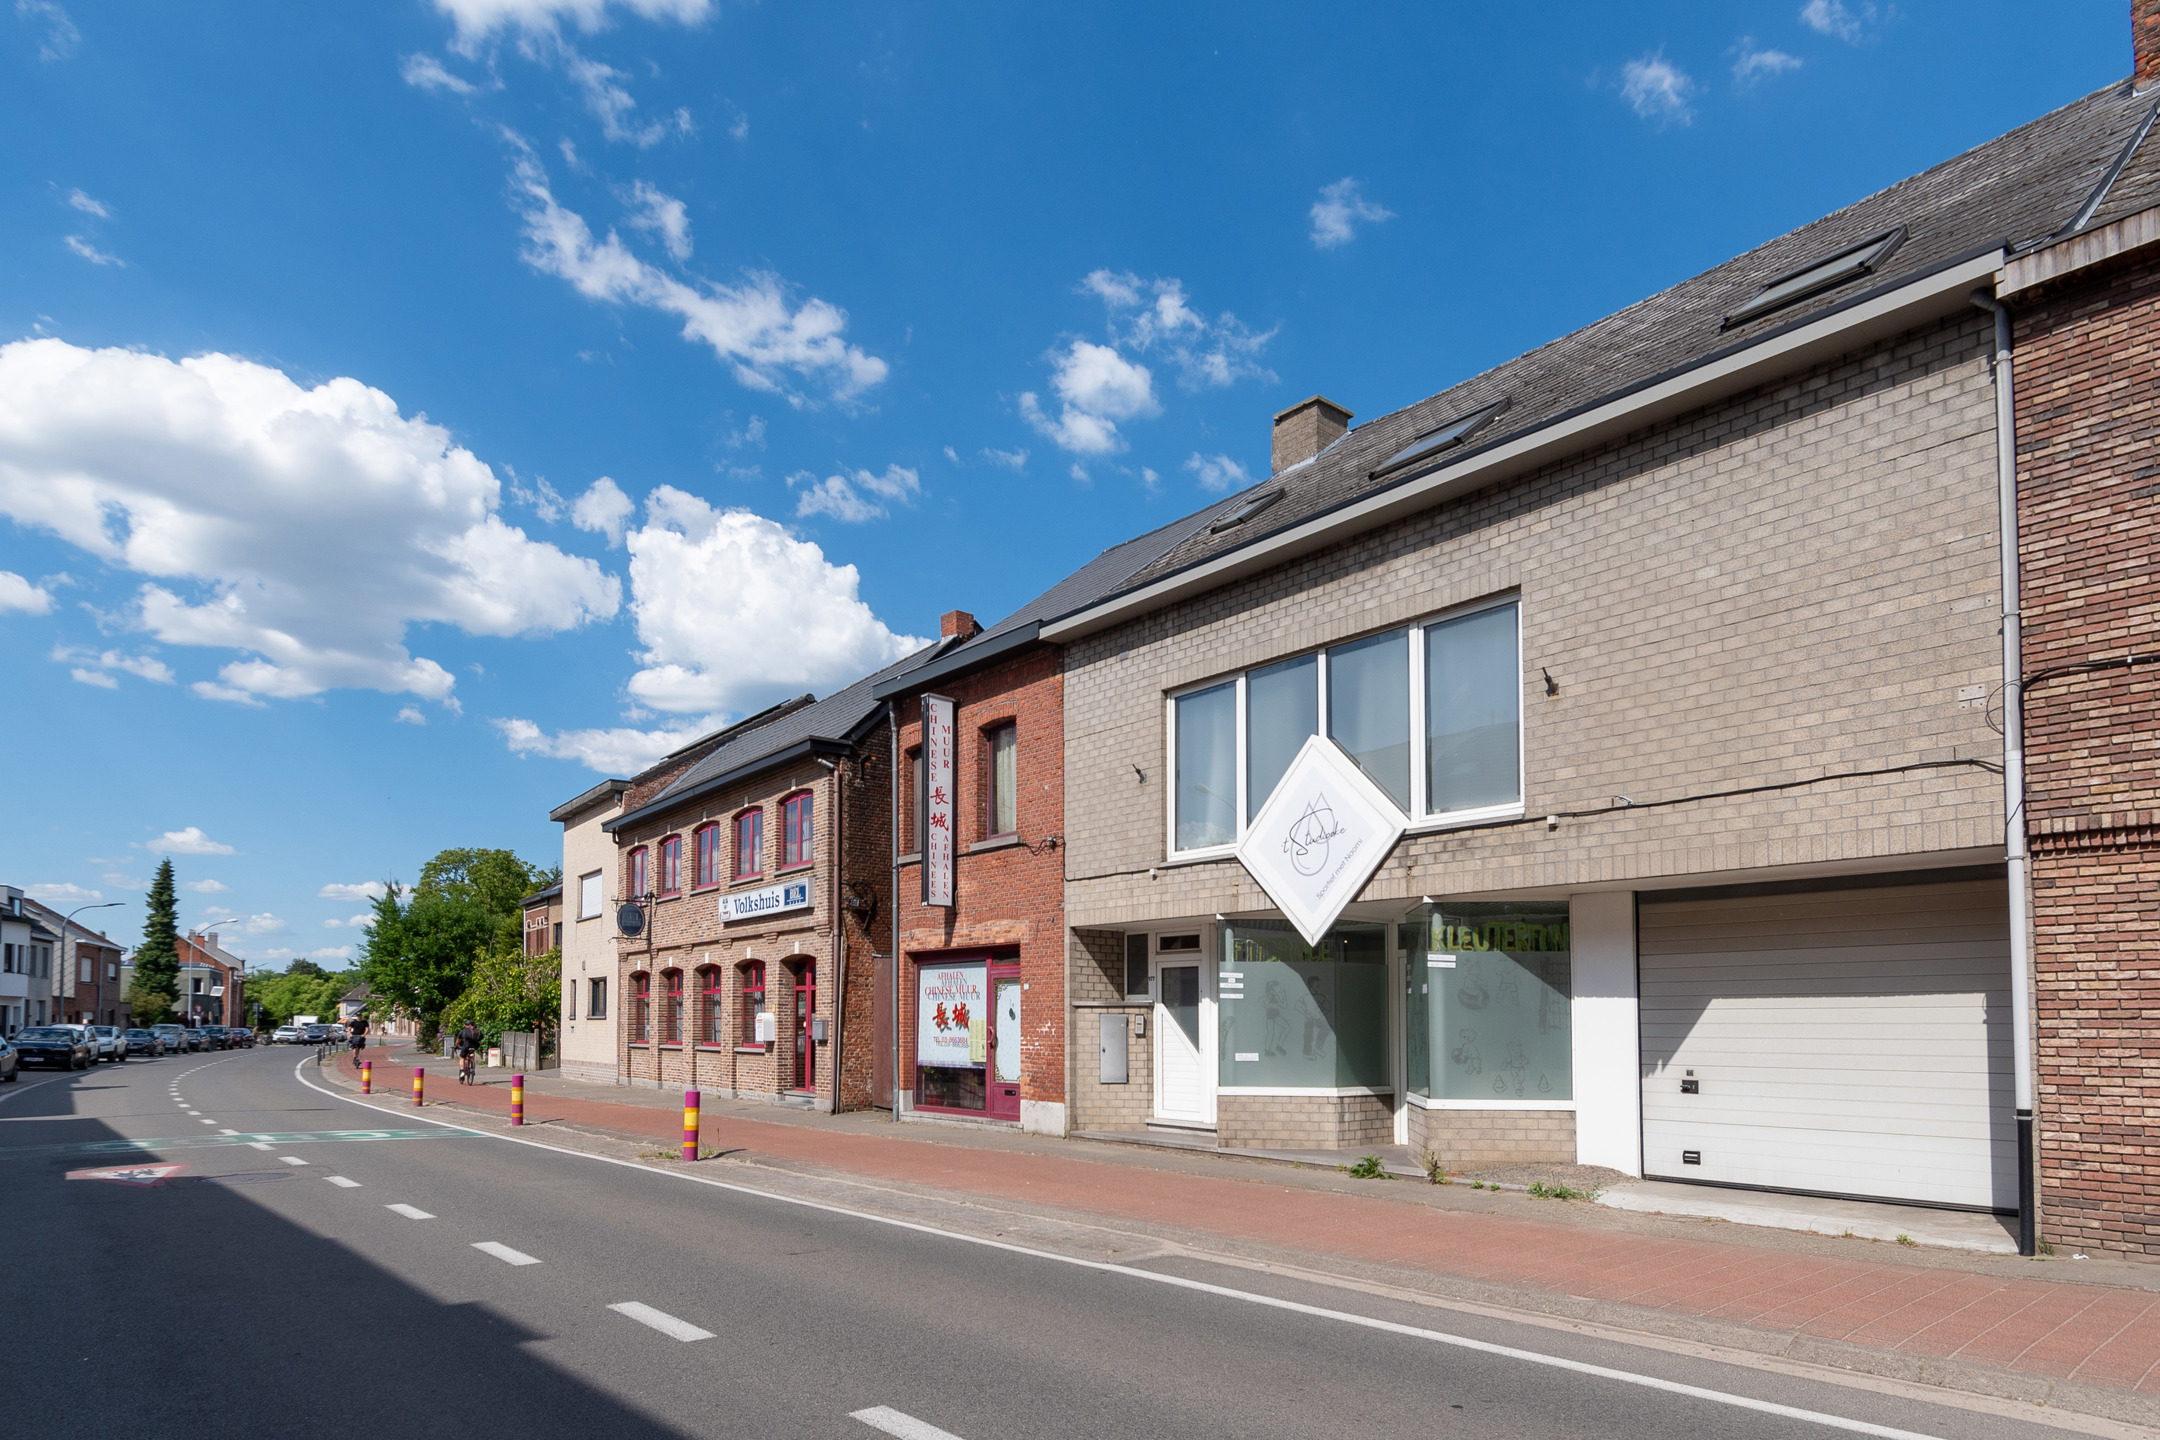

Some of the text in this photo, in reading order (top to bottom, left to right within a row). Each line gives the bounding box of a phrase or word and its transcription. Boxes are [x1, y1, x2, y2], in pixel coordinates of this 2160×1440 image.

[930, 703, 951, 782] CHINESE MUUR
[930, 786, 949, 832] 長城
[1335, 860, 1346, 875] met
[1344, 837, 1363, 862] Naomi
[734, 891, 780, 914] Volkshuis
[937, 971, 964, 981] AFHALEN
[924, 985, 978, 996] CHINESE MUUR
[932, 1001, 970, 1029] 長城
